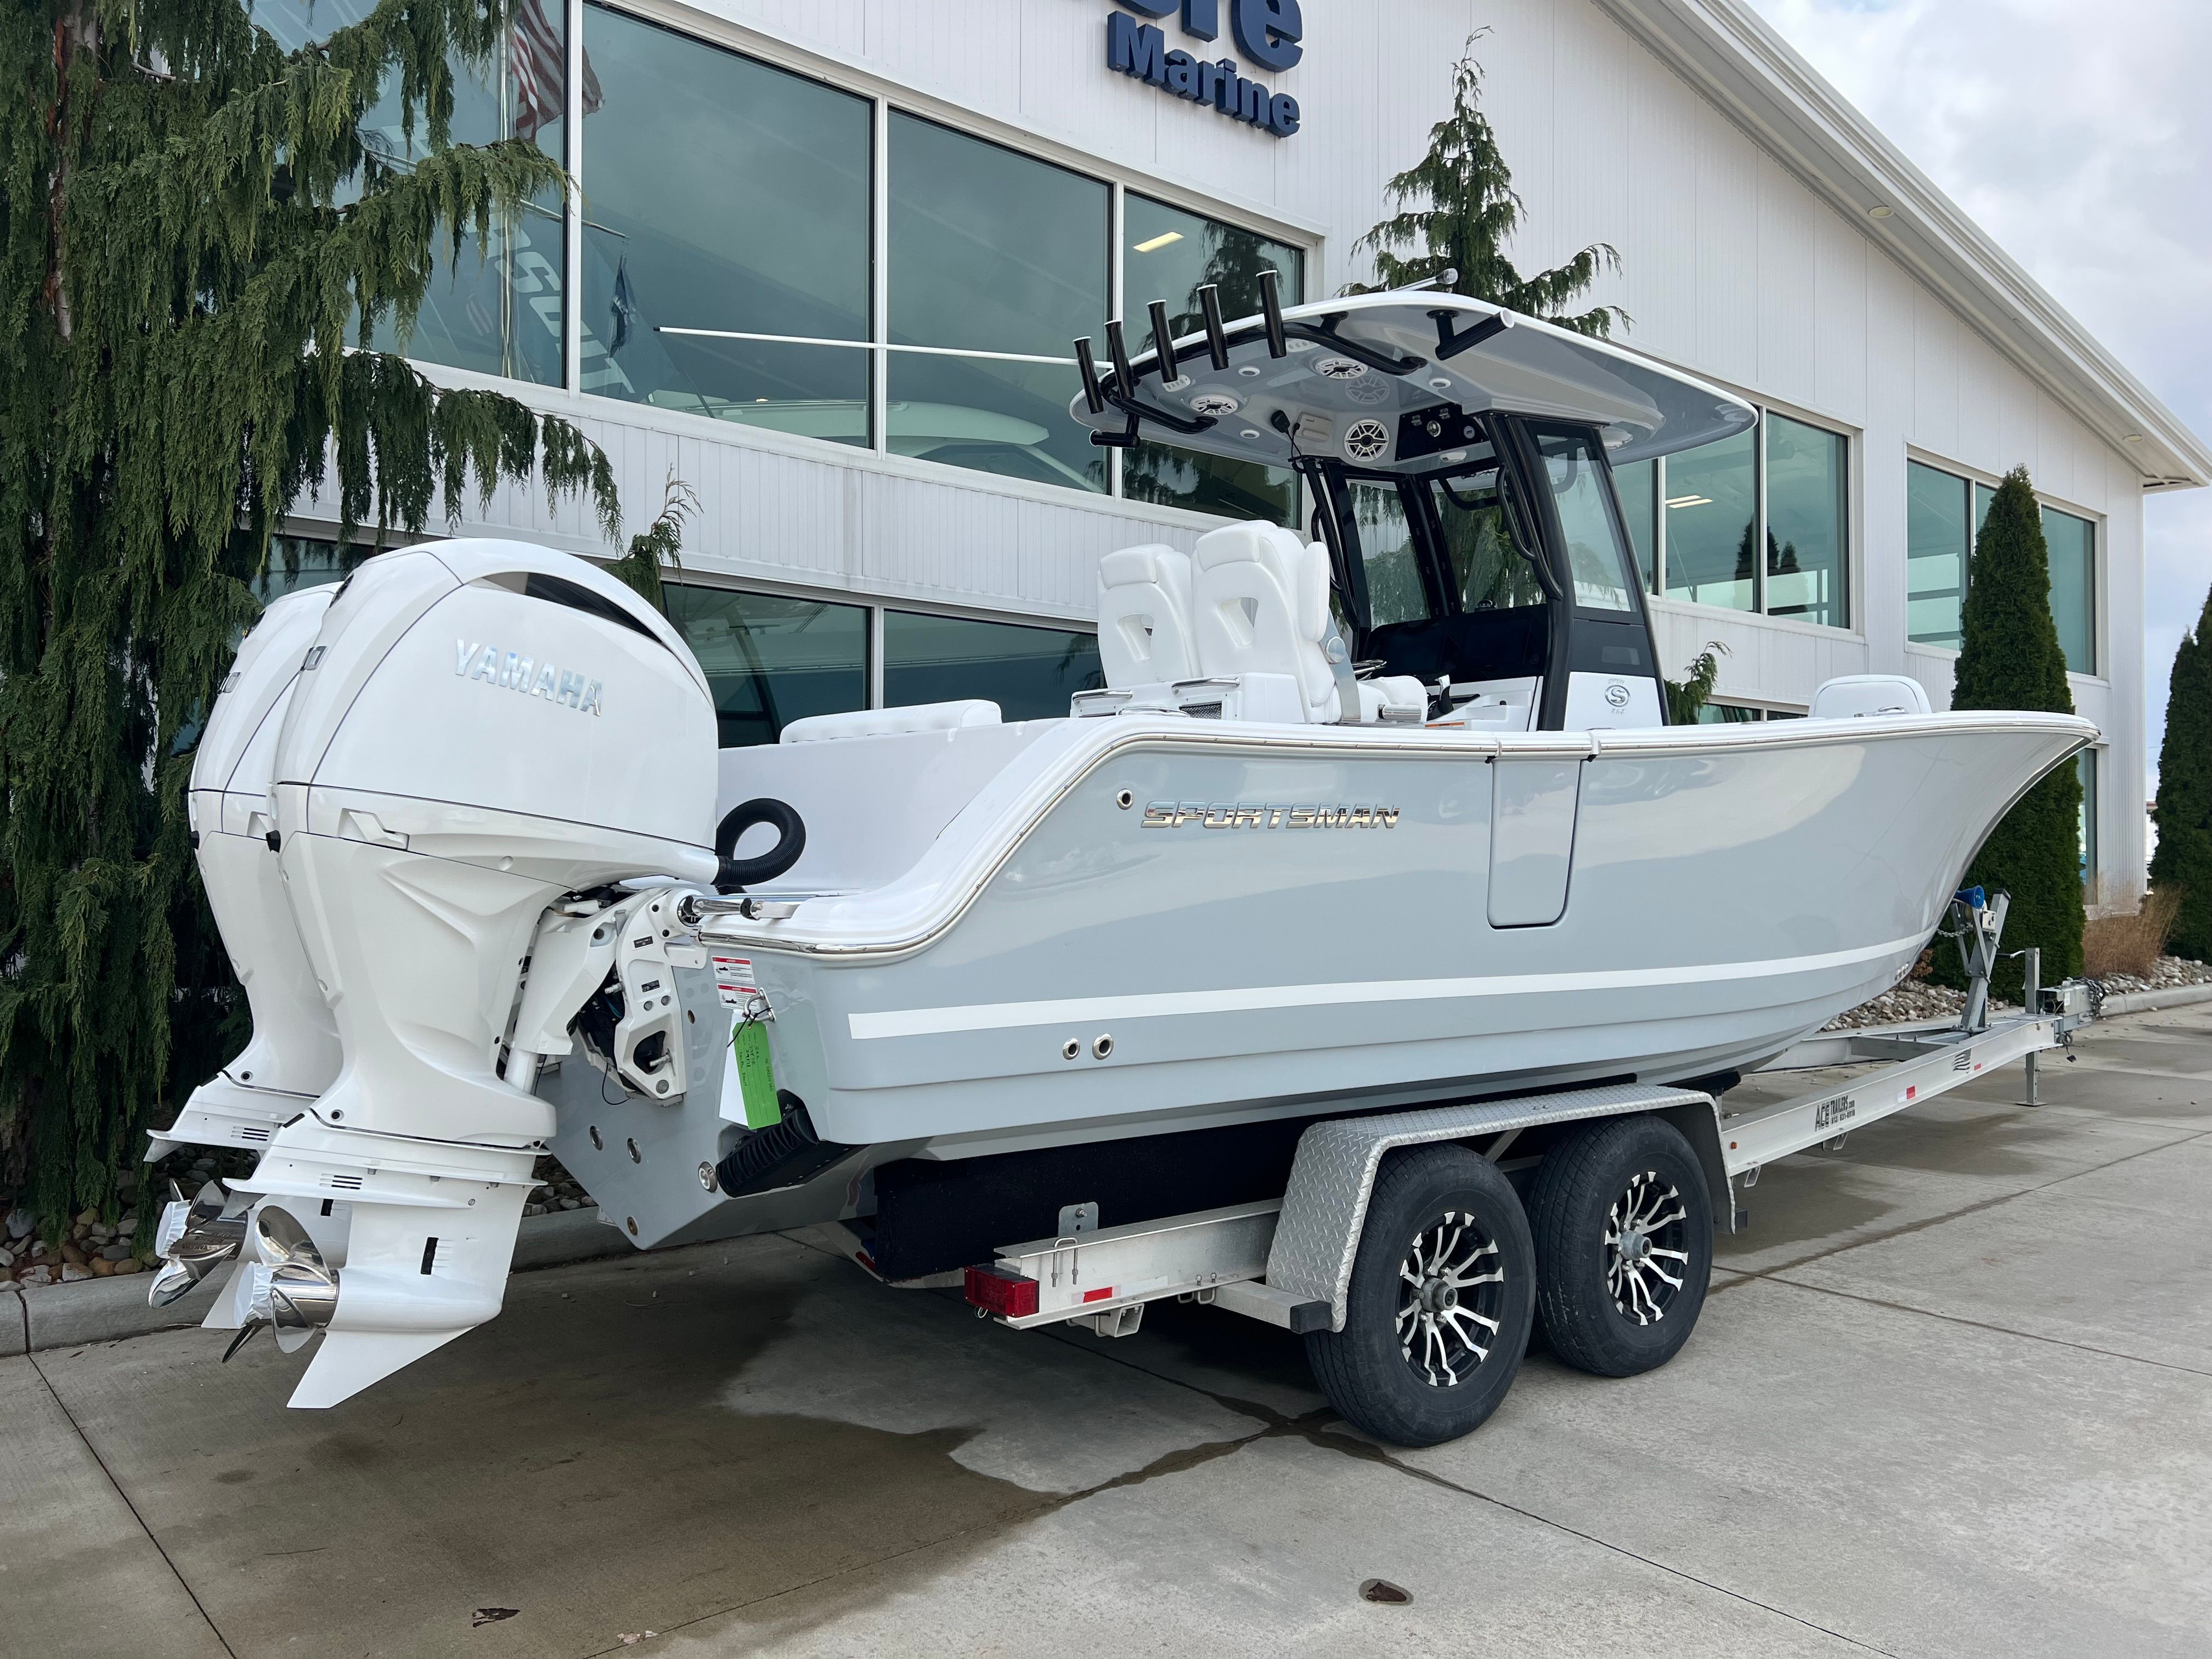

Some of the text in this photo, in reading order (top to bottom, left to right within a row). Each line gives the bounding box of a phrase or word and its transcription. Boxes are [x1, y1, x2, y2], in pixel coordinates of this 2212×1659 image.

[1108, 10, 1300, 138] Marine
[455, 638, 603, 716] YAMAHA
[1141, 800, 1400, 828] SPORTSMAN
[1815, 1102, 1830, 1132] ACE
